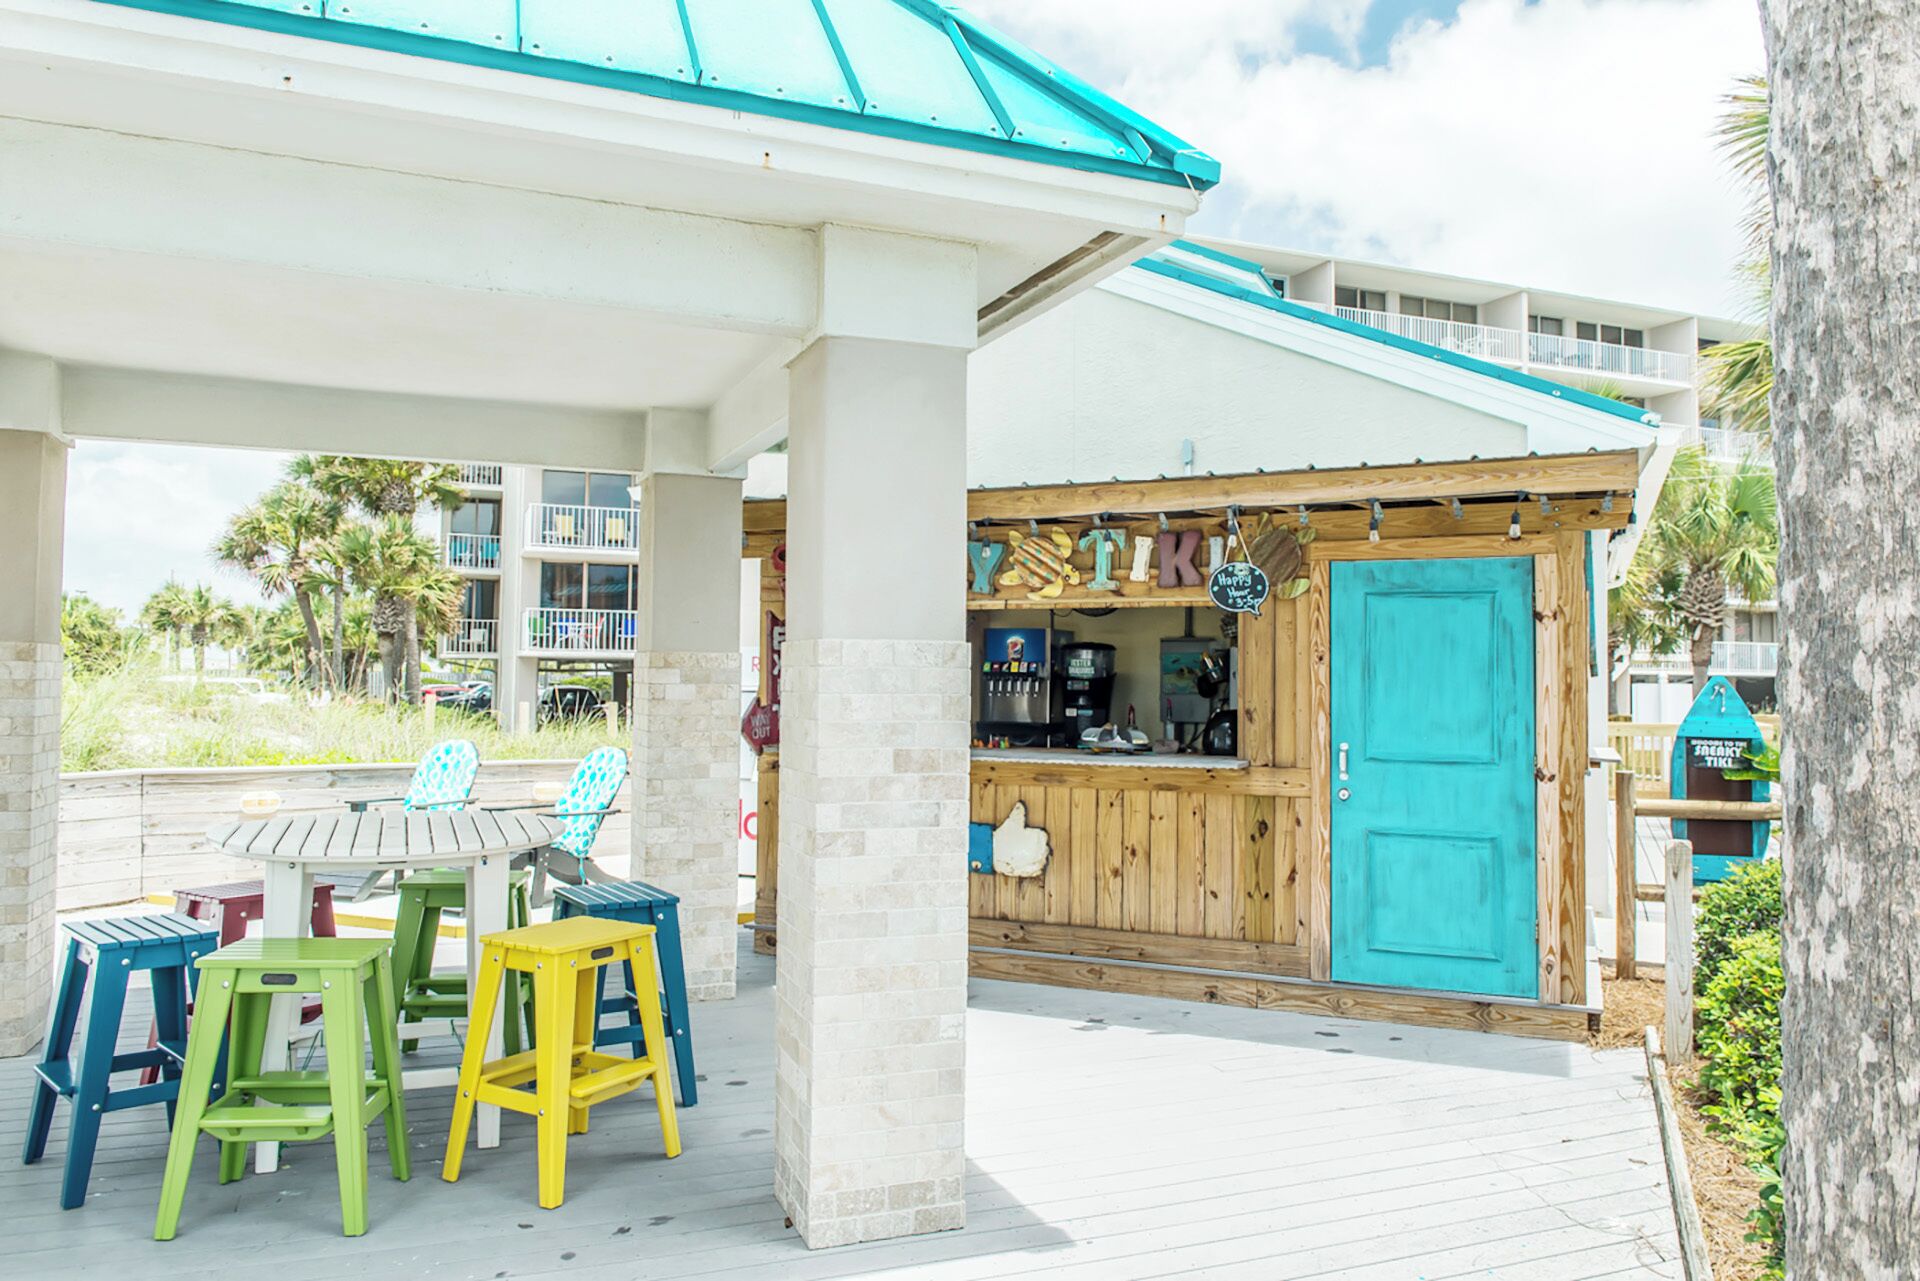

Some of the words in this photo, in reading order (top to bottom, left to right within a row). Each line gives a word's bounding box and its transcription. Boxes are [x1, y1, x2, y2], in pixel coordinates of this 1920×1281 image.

[1077, 527, 1225, 591] TIKI
[1217, 572, 1252, 587] Happy
[1226, 586, 1251, 599] Hour
[751, 714, 771, 726] WAY
[751, 726, 771, 739] OUT
[1693, 745, 1743, 758] SNEAKY
[1704, 756, 1733, 768] TIKI
